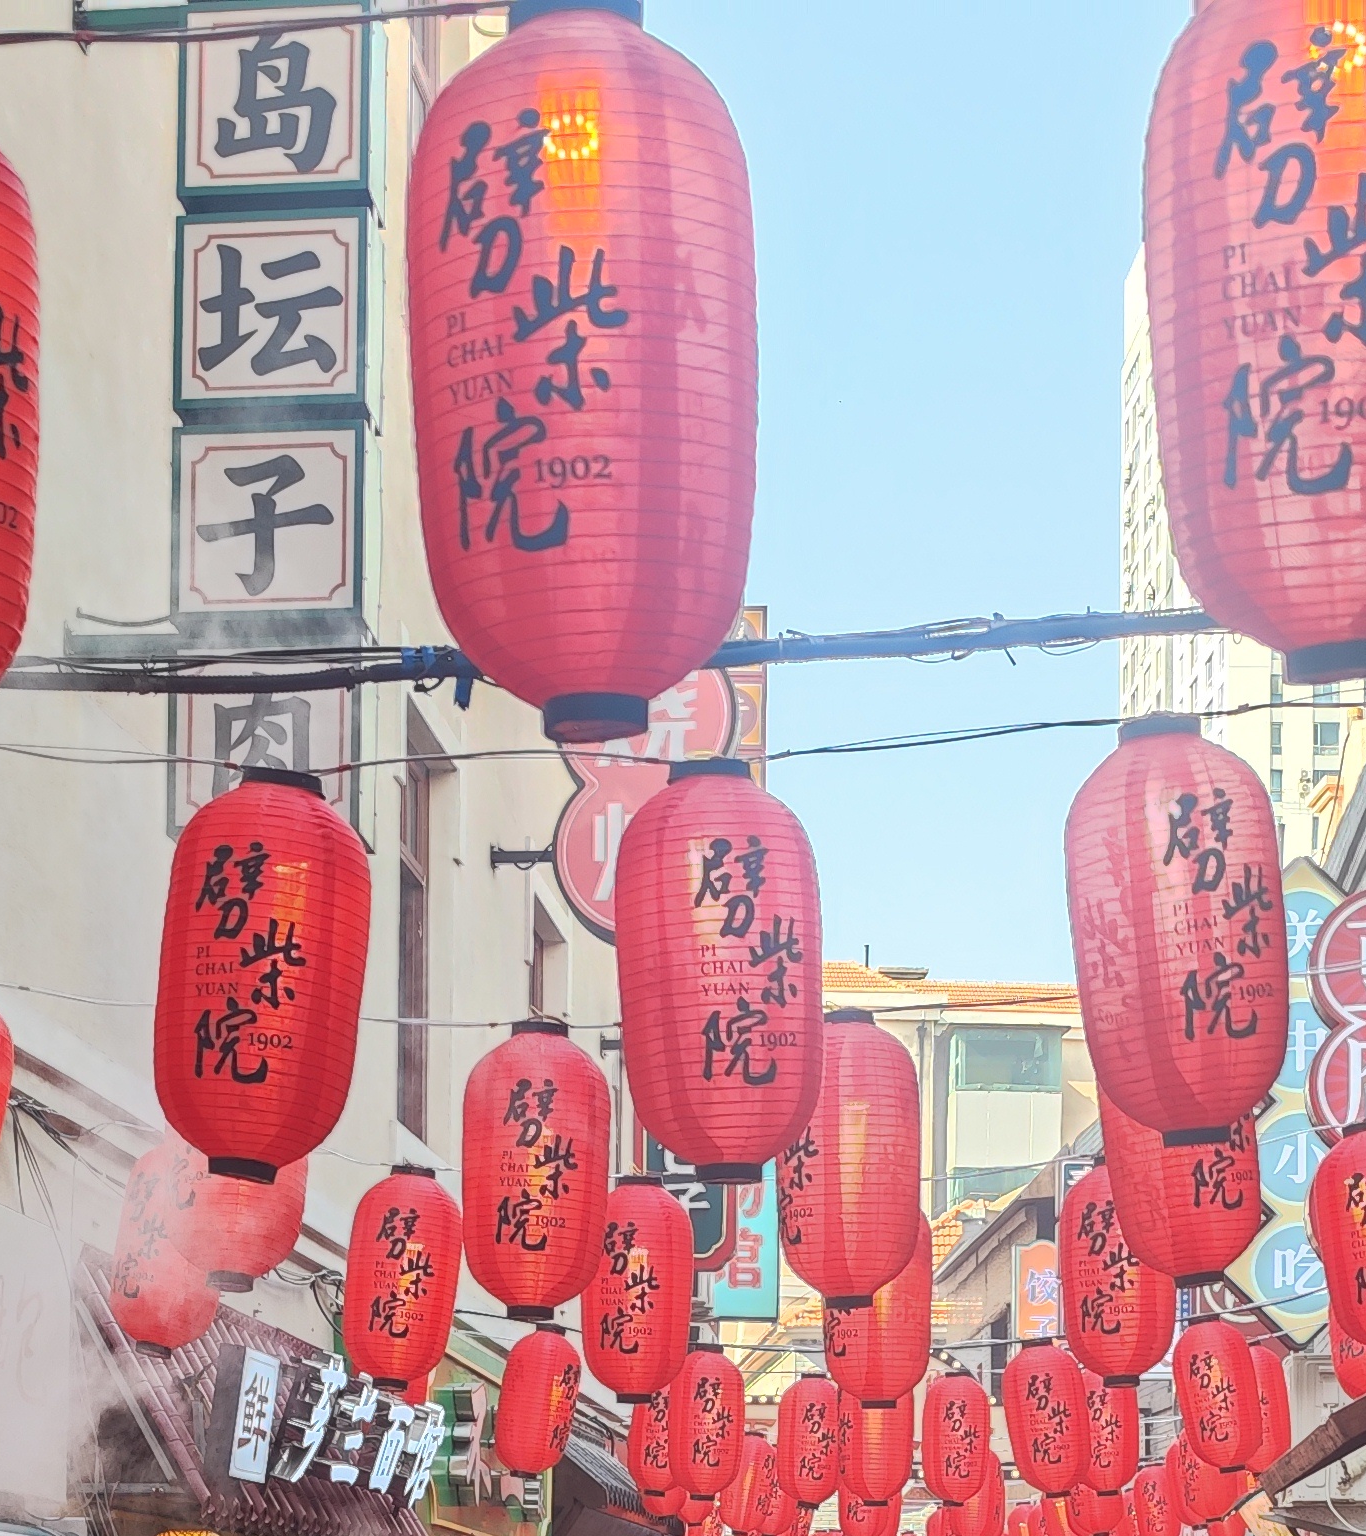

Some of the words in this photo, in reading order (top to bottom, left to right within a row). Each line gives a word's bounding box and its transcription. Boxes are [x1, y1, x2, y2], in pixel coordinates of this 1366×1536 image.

[1222, 245, 1248, 270] PI
[1222, 262, 1295, 301] CHAI
[440, 108, 628, 553] 劈柴院
[445, 313, 467, 336] PI
[1222, 306, 1304, 342] YUAN
[446, 334, 505, 368] CHAI
[447, 368, 515, 406] YUAN
[535, 454, 613, 488] 1902
[1163, 788, 1273, 1042] 劈柴院
[1173, 903, 1190, 917] PI
[1173, 916, 1219, 936] CHAI
[196, 946, 211, 960] PI
[700, 945, 717, 958] PI
[1174, 936, 1227, 954] YUAN
[194, 841, 307, 1085] 劈柴院
[195, 961, 235, 977] CHAI
[695, 834, 804, 1086] 劈柴院
[700, 959, 748, 976] CHAI
[195, 982, 240, 997] YUAN
[700, 980, 751, 996] YUAN
[1238, 983, 1275, 1003] 1902
[248, 1031, 294, 1052] 1902
[759, 1031, 798, 1049] 1902
[501, 1149, 514, 1161] PI
[495, 1078, 579, 1253] 劈柴院
[500, 1161, 530, 1174] CHAI
[1230, 1169, 1254, 1182] 1902
[499, 1176, 533, 1188] YUAN
[535, 1213, 567, 1230] 1902
[788, 1206, 815, 1222] 1902
[369, 1207, 435, 1340] 劈柴院
[1077, 1200, 1141, 1336] 劈柴院
[600, 1221, 661, 1356] 劈柴院
[399, 1310, 425, 1323] 1902
[1108, 1303, 1136, 1316] 1902
[627, 1324, 654, 1338] 1902
[836, 1328, 859, 1339] 1902
[1189, 1350, 1237, 1443] 劈柴院
[692, 1376, 733, 1469] 劈柴院
[1026, 1372, 1072, 1465] 劈柴院
[798, 1401, 838, 1481] 劈柴院
[942, 1400, 982, 1480] 劈柴院
